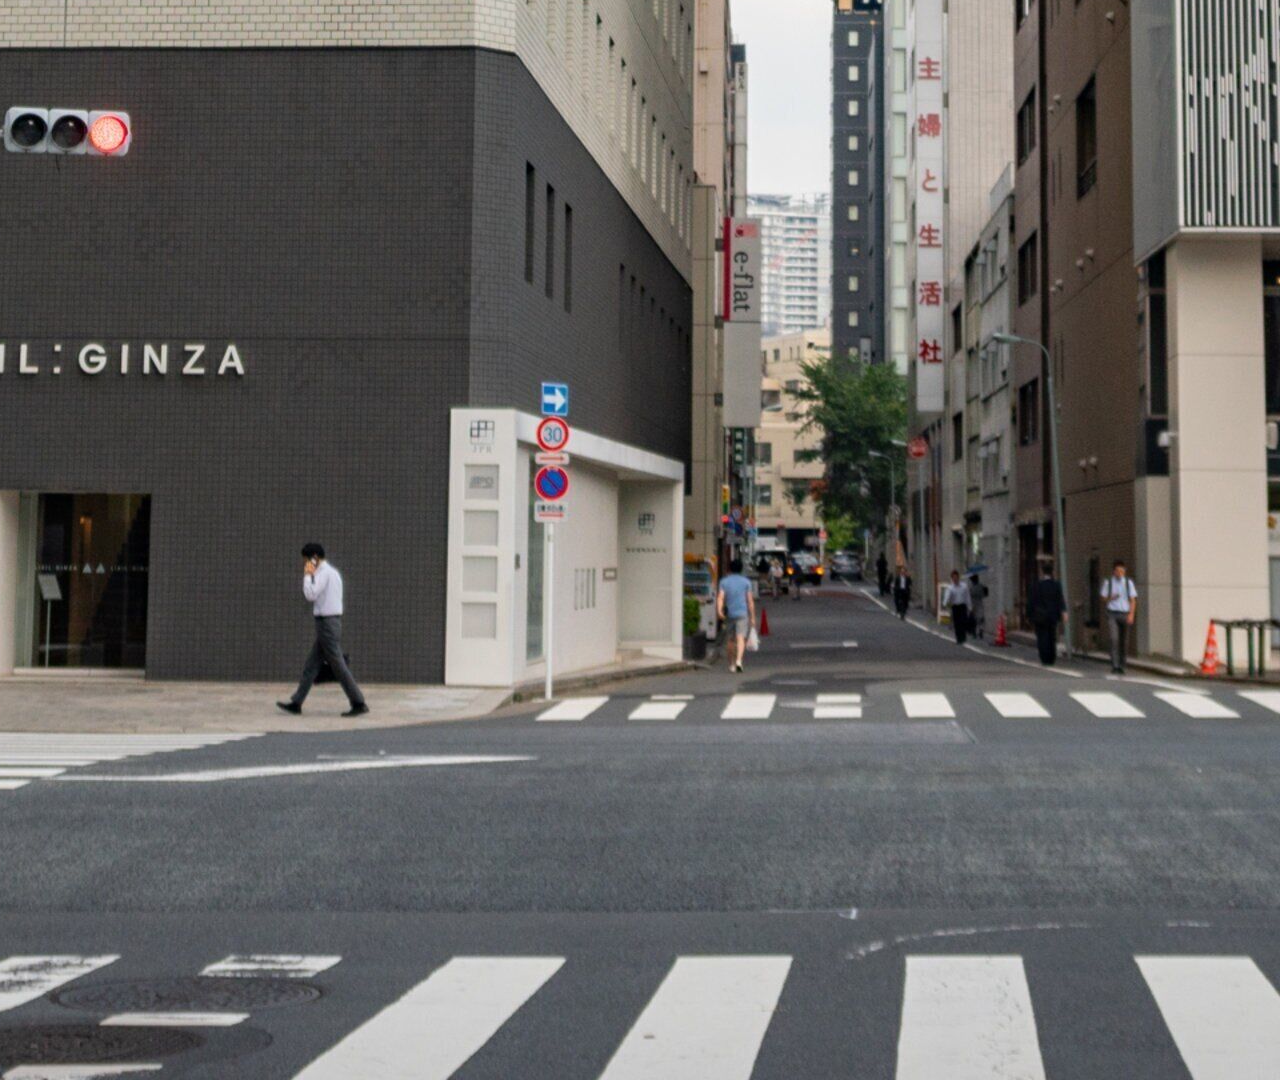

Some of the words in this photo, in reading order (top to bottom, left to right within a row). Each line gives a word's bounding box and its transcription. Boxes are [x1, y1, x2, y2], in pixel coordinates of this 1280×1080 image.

[918, 56, 942, 365] 主婦と生活社
[733, 251, 754, 312] e-flat
[543, 426, 563, 443] 30
